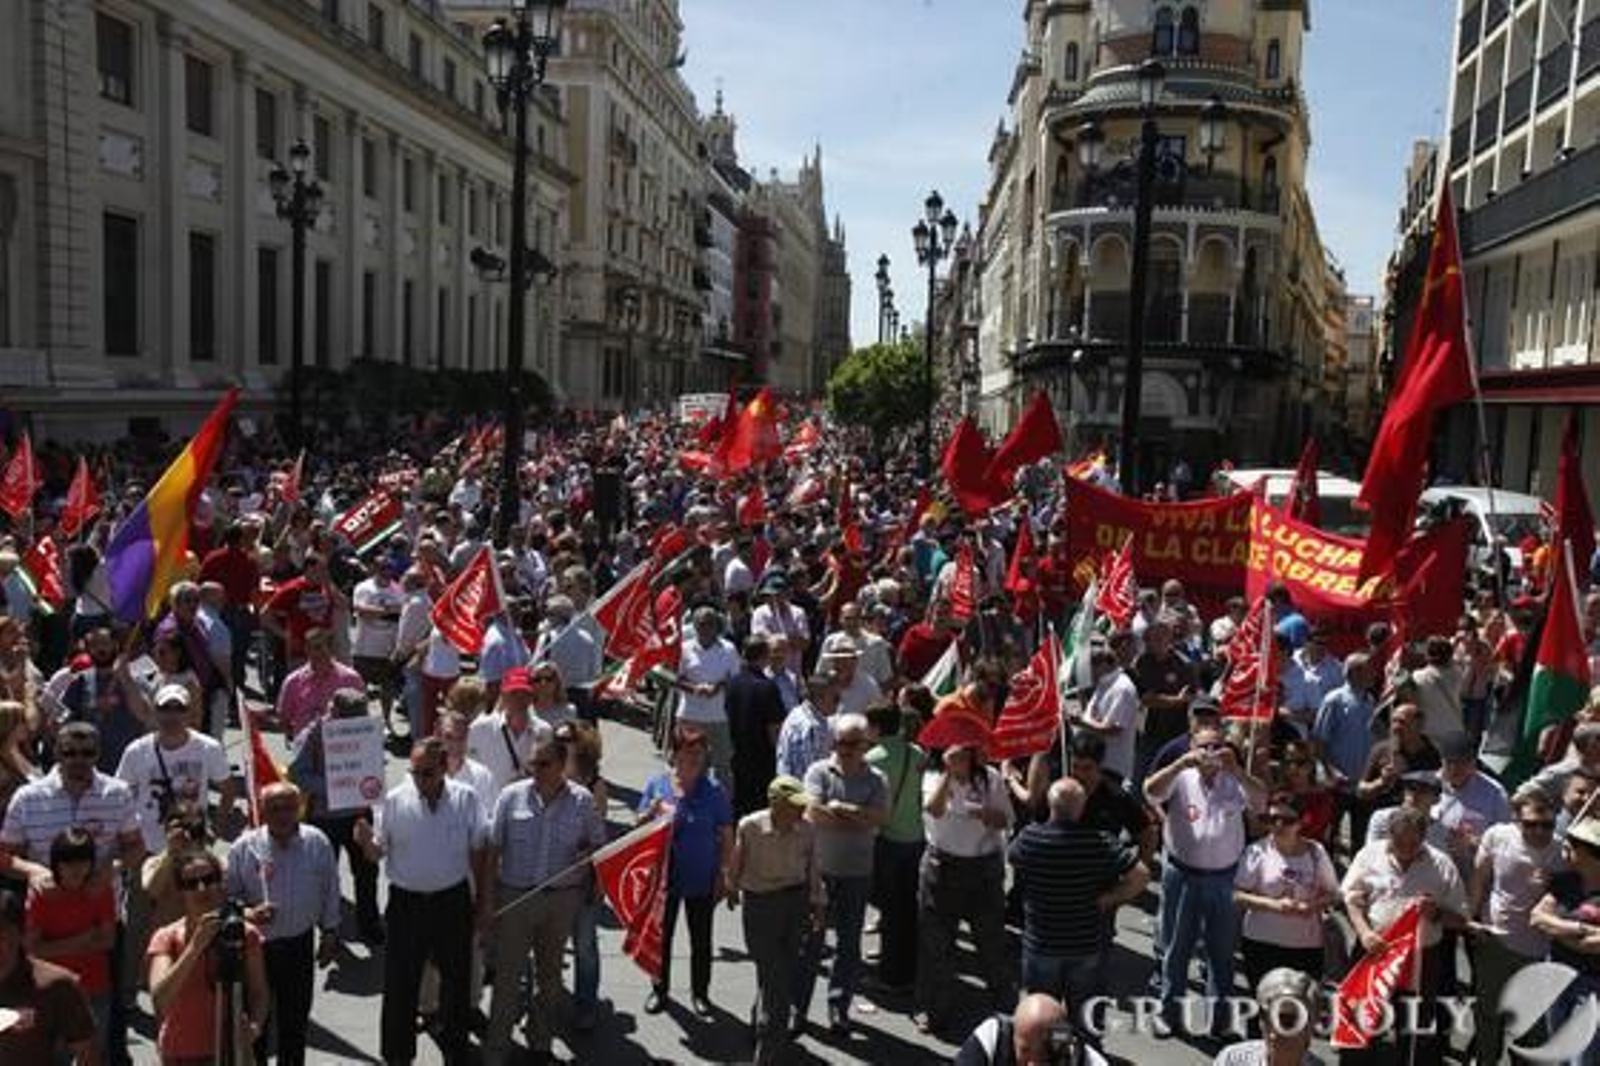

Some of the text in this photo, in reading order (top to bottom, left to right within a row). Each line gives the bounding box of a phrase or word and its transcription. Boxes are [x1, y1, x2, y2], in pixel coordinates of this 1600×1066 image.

[1144, 533, 1183, 561] LA
[1150, 504, 1363, 570] VIVA LA LUCHA
